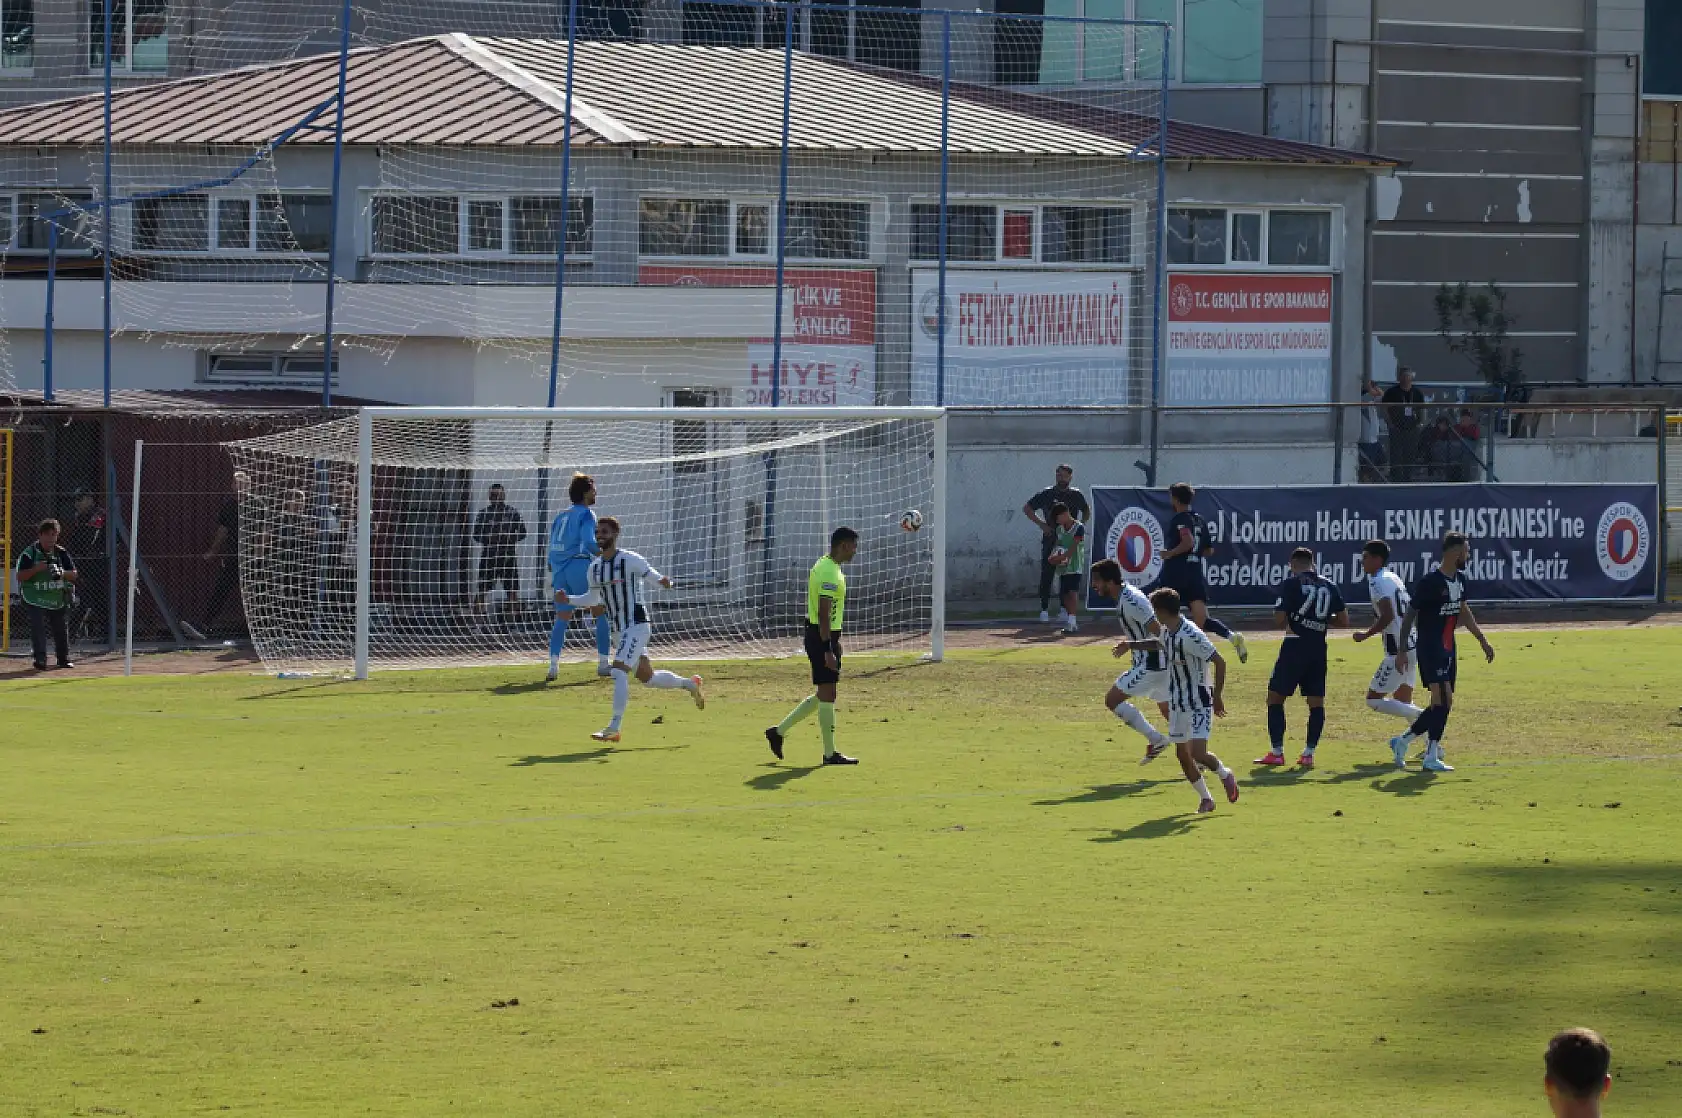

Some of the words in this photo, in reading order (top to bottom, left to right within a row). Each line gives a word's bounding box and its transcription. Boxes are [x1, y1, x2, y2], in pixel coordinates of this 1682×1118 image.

[795, 284, 819, 306] LİK
[822, 287, 842, 306] VE
[1194, 291, 1210, 309] T.C.
[1212, 289, 1248, 313] GENÇLİK
[1250, 292, 1261, 309] VE
[1264, 292, 1285, 309] SPOR
[1286, 289, 1329, 309] BAKANLIĞI
[795, 313, 850, 336] ANLIĞI
[959, 279, 1015, 346] FETHİYE
[1017, 280, 1124, 346] KAYMAKAMLIĞI
[751, 359, 837, 386] HİYE
[1208, 509, 1225, 543] el
[1230, 509, 1309, 544] Lokman
[1315, 508, 1378, 542] Hekim
[1384, 508, 1444, 540] ESNAF
[1450, 500, 1585, 539] HASTANESİ'ne
[1511, 548, 1569, 581] Ederiz
[1298, 585, 1331, 618] 70
